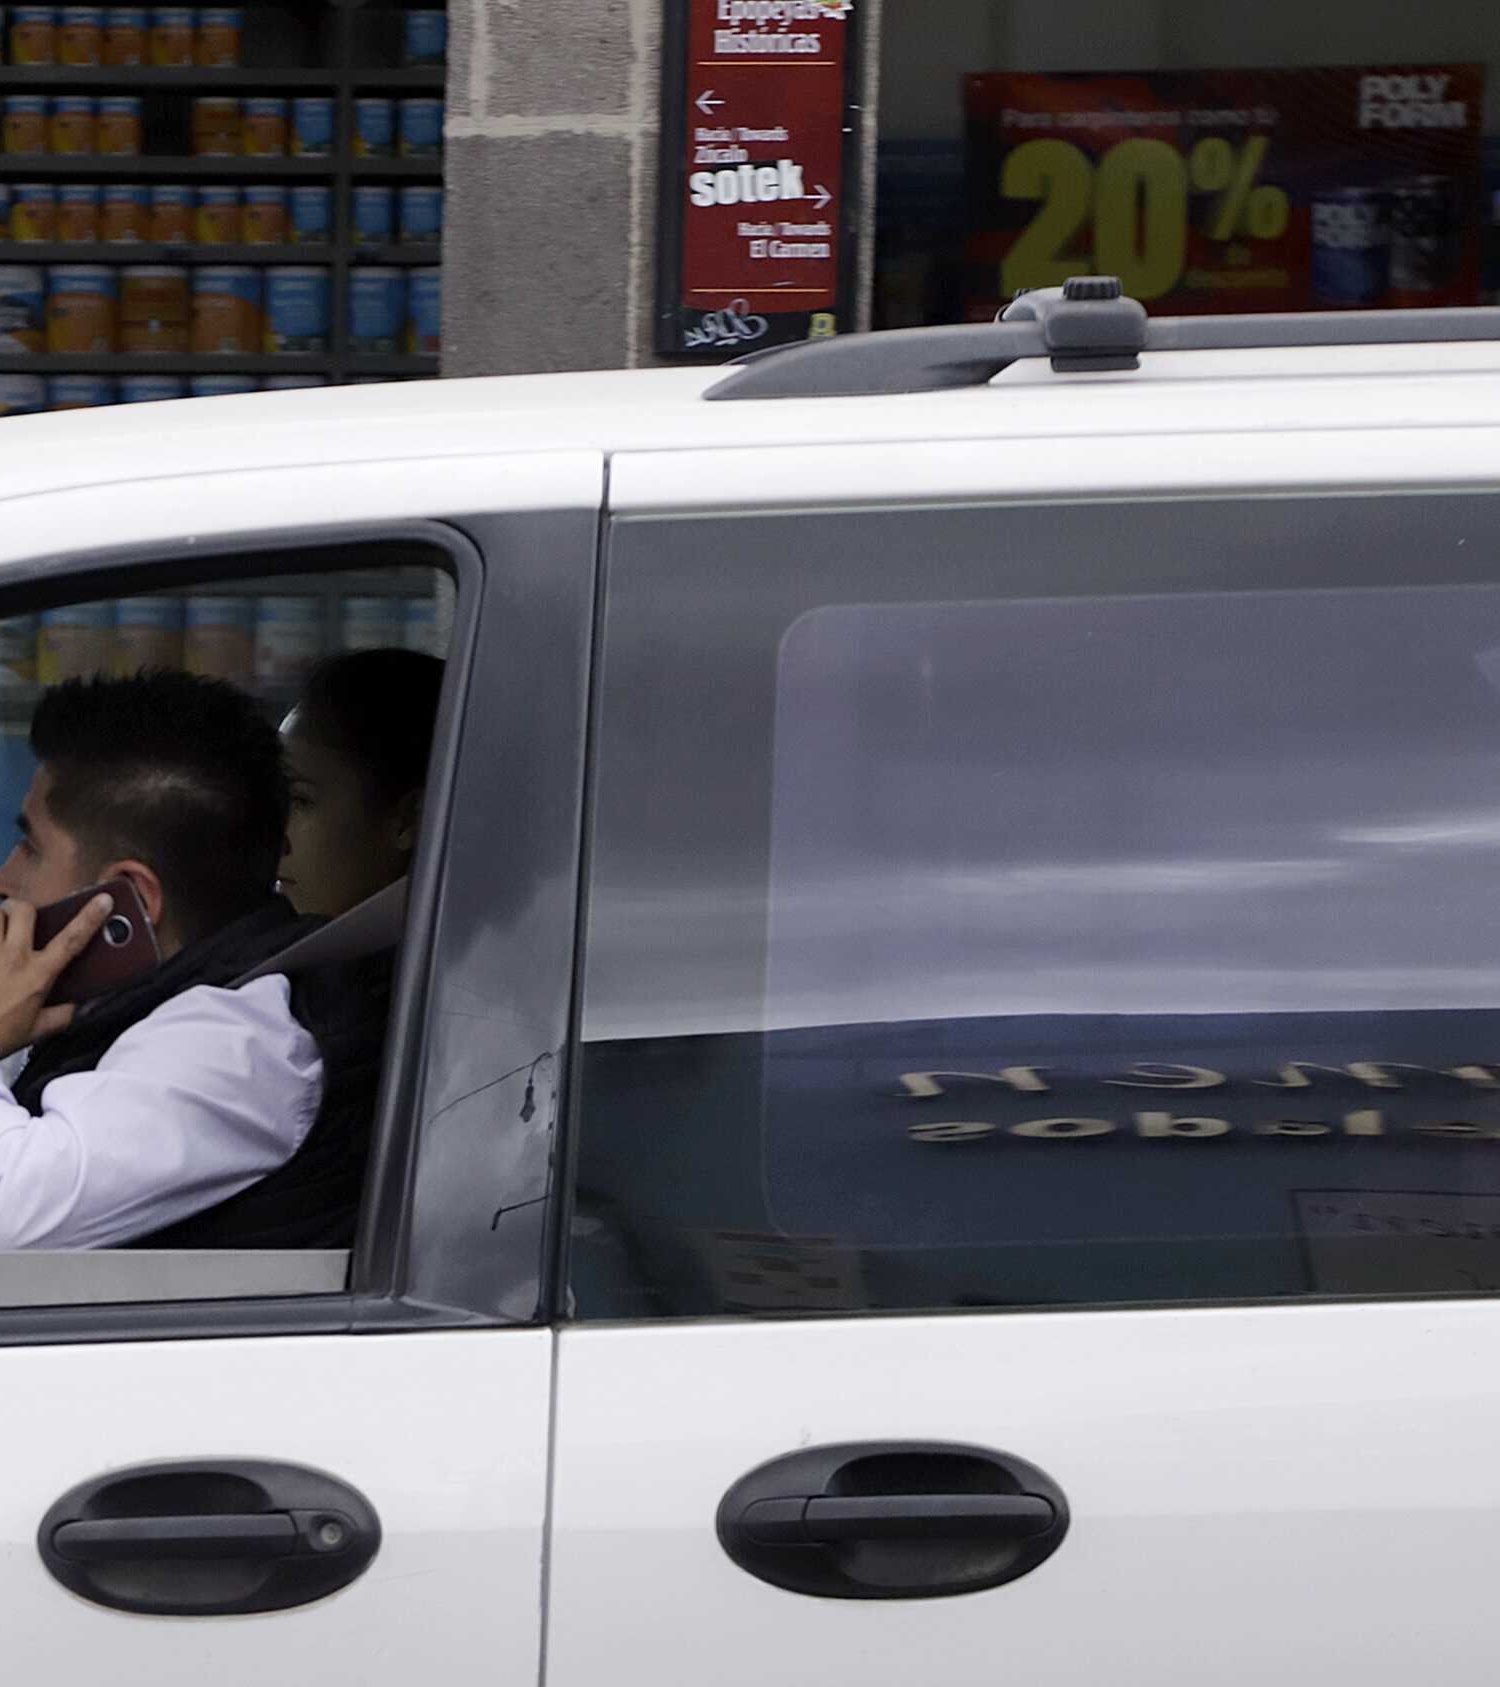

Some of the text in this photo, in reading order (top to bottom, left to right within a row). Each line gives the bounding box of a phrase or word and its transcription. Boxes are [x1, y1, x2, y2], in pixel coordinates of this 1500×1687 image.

[1361, 75, 1450, 100] POLY
[1359, 101, 1466, 128] FORM
[689, 159, 804, 207] sotek
[1001, 136, 1289, 301] 20%
